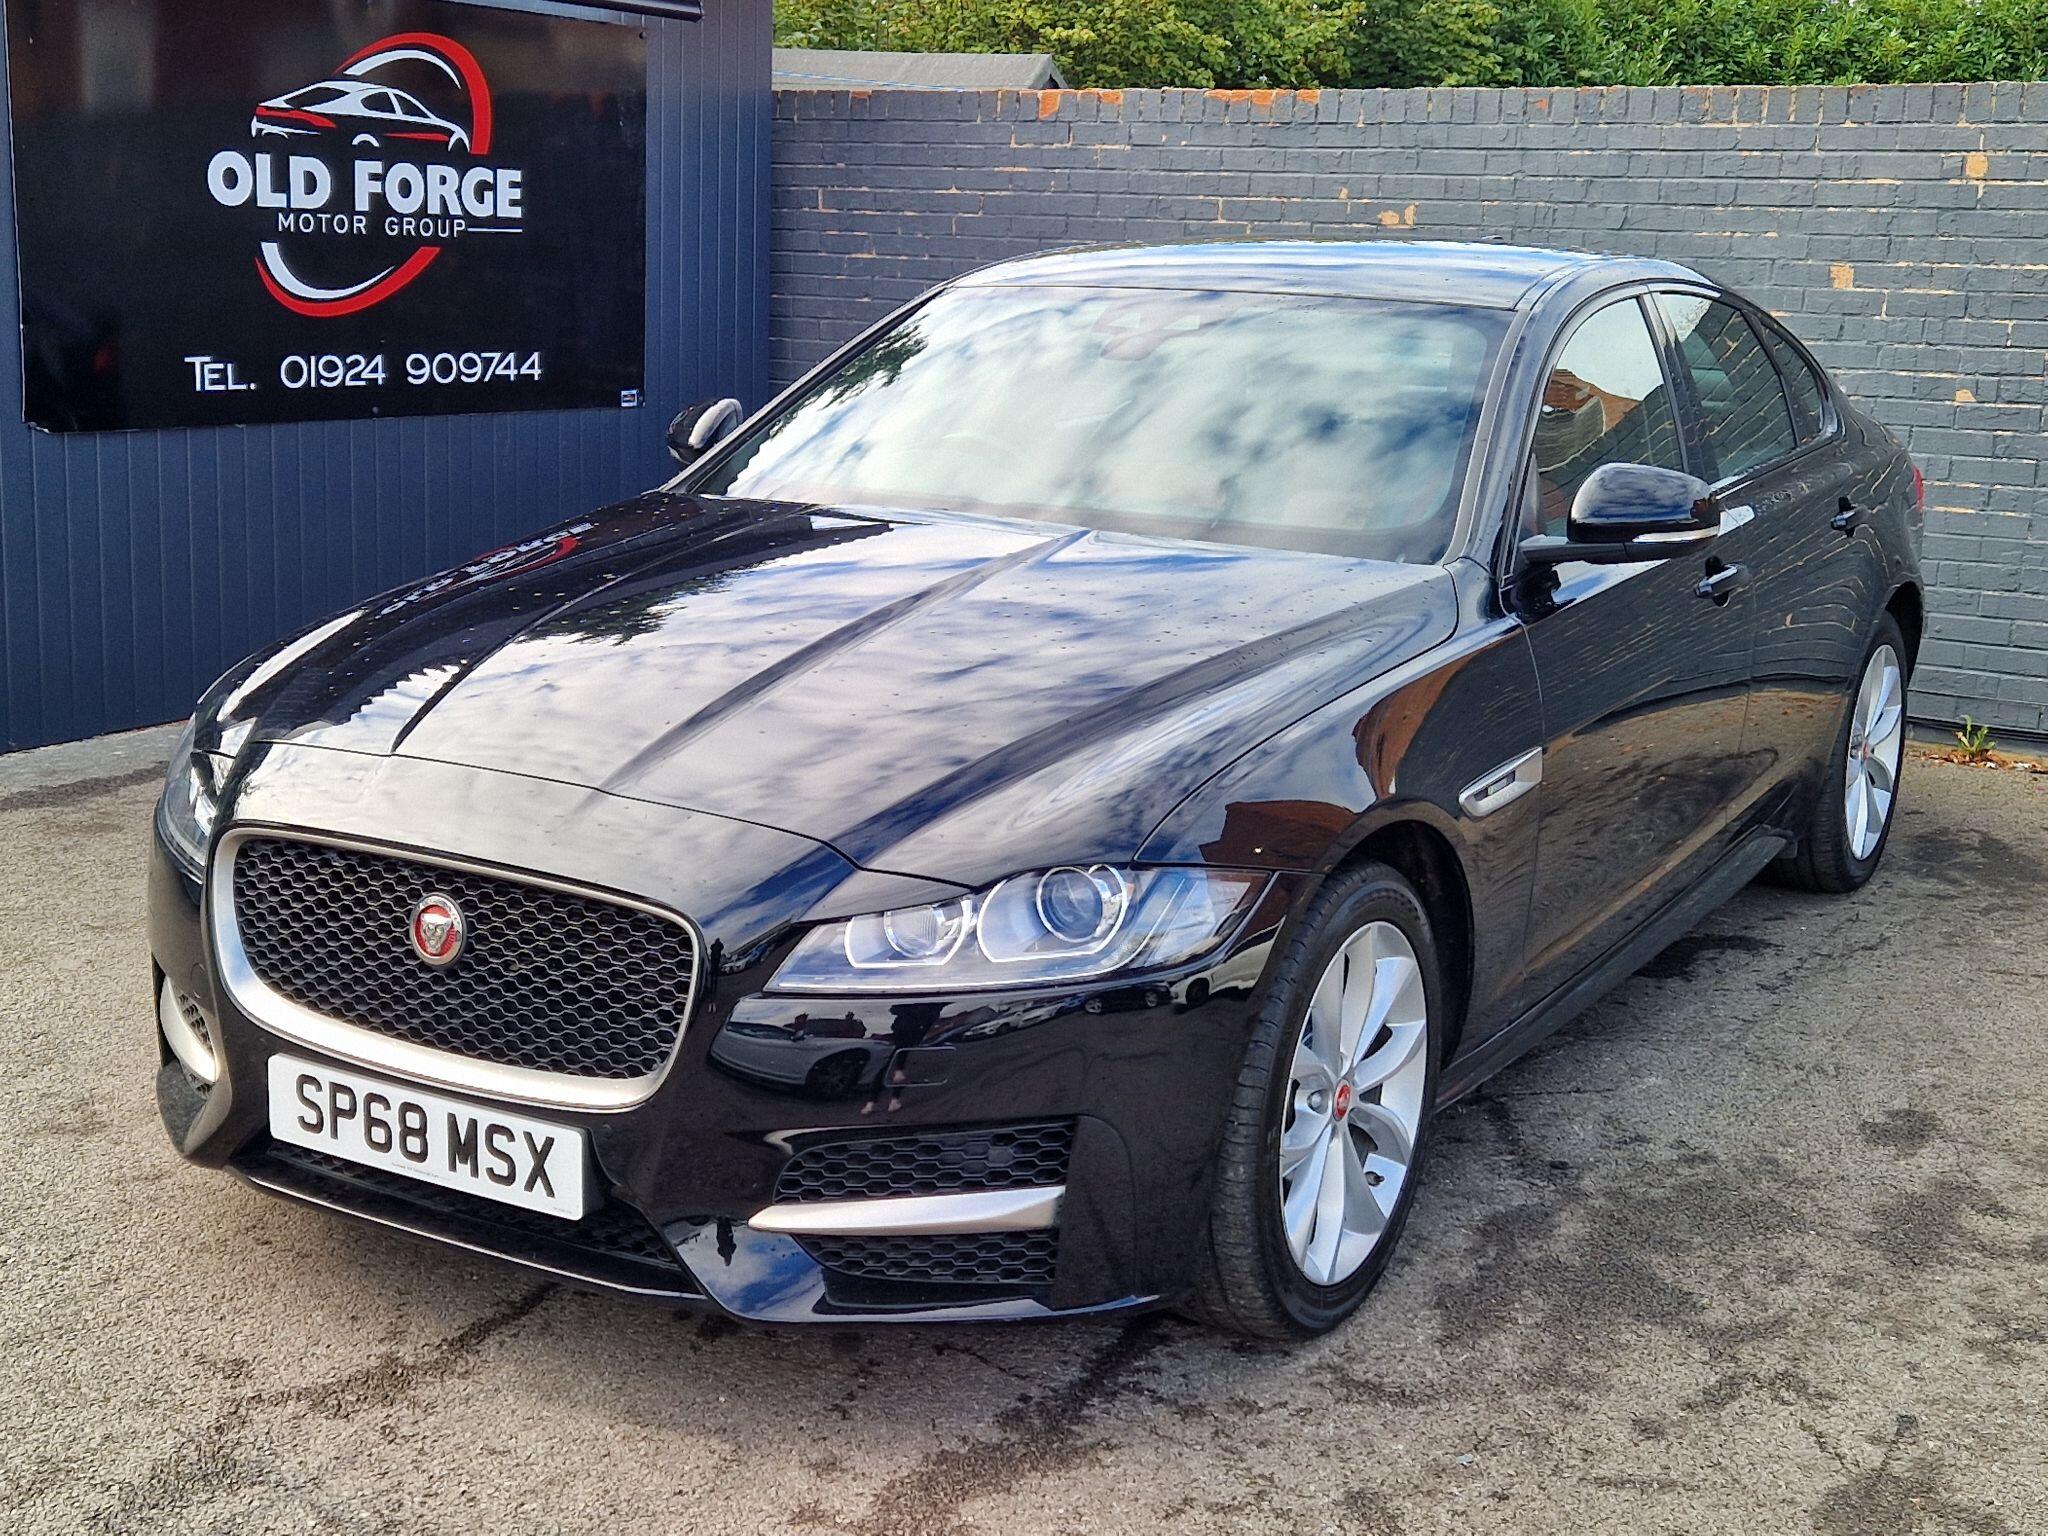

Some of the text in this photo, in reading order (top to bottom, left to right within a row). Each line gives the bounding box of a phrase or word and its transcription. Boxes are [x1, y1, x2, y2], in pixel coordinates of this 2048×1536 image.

[207, 151, 522, 219] OLD FORGE
[278, 213, 466, 238] MOTOR GROUP
[280, 353, 387, 389] 01924
[405, 352, 542, 385] 909744
[296, 1073, 556, 1199] SP68 MSX
